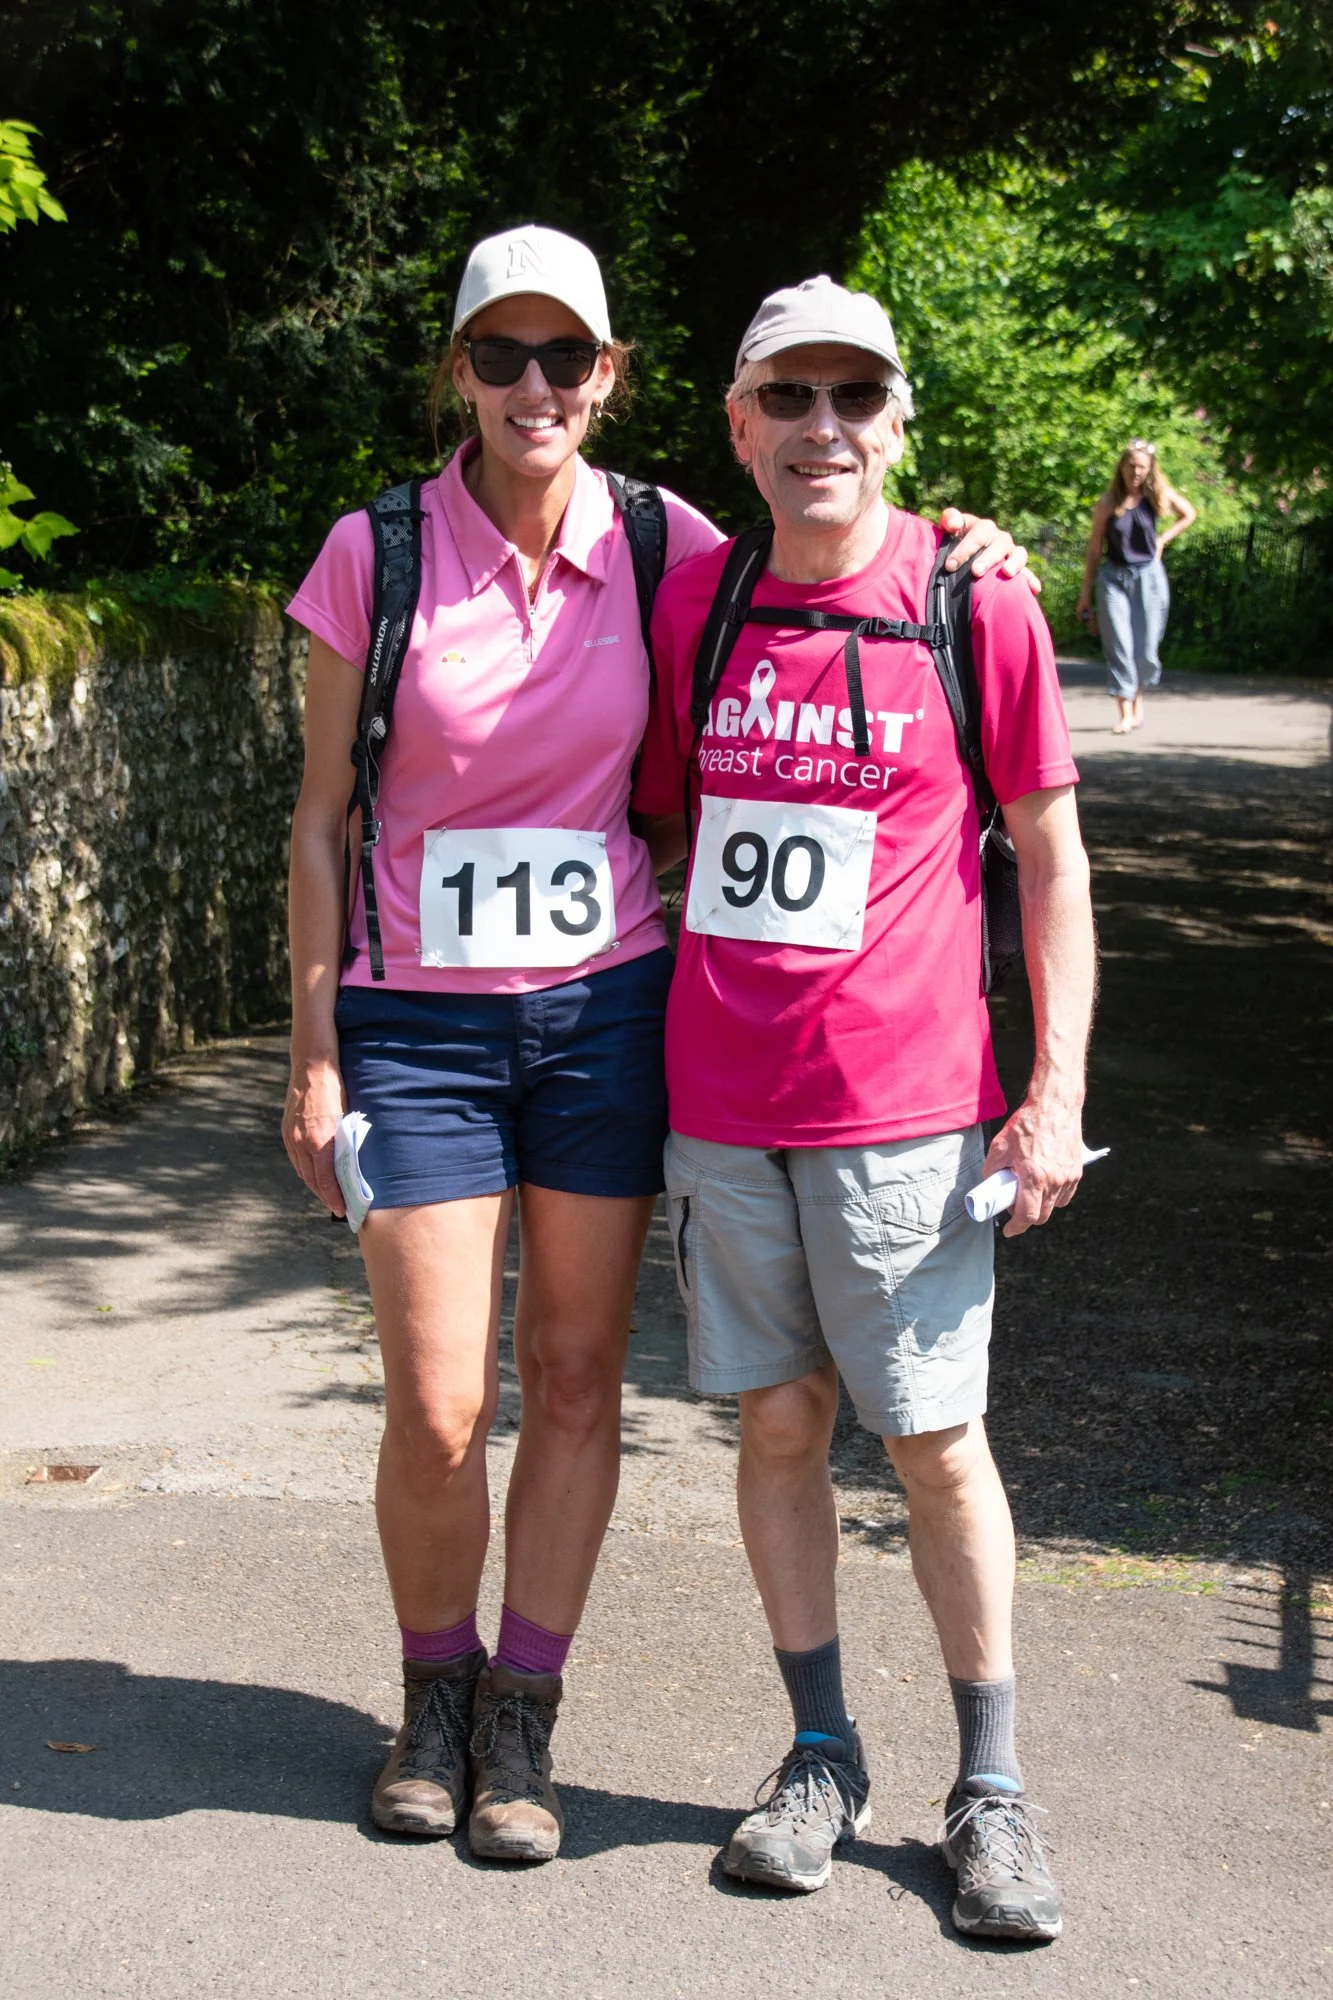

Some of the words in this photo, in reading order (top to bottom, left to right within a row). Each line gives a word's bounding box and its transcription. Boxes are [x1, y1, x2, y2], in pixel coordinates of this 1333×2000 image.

[507, 239, 556, 279] N
[370, 616, 389, 687] SALOMON
[775, 754, 898, 790] cancer
[442, 860, 601, 936] 113
[721, 831, 826, 912] 90
